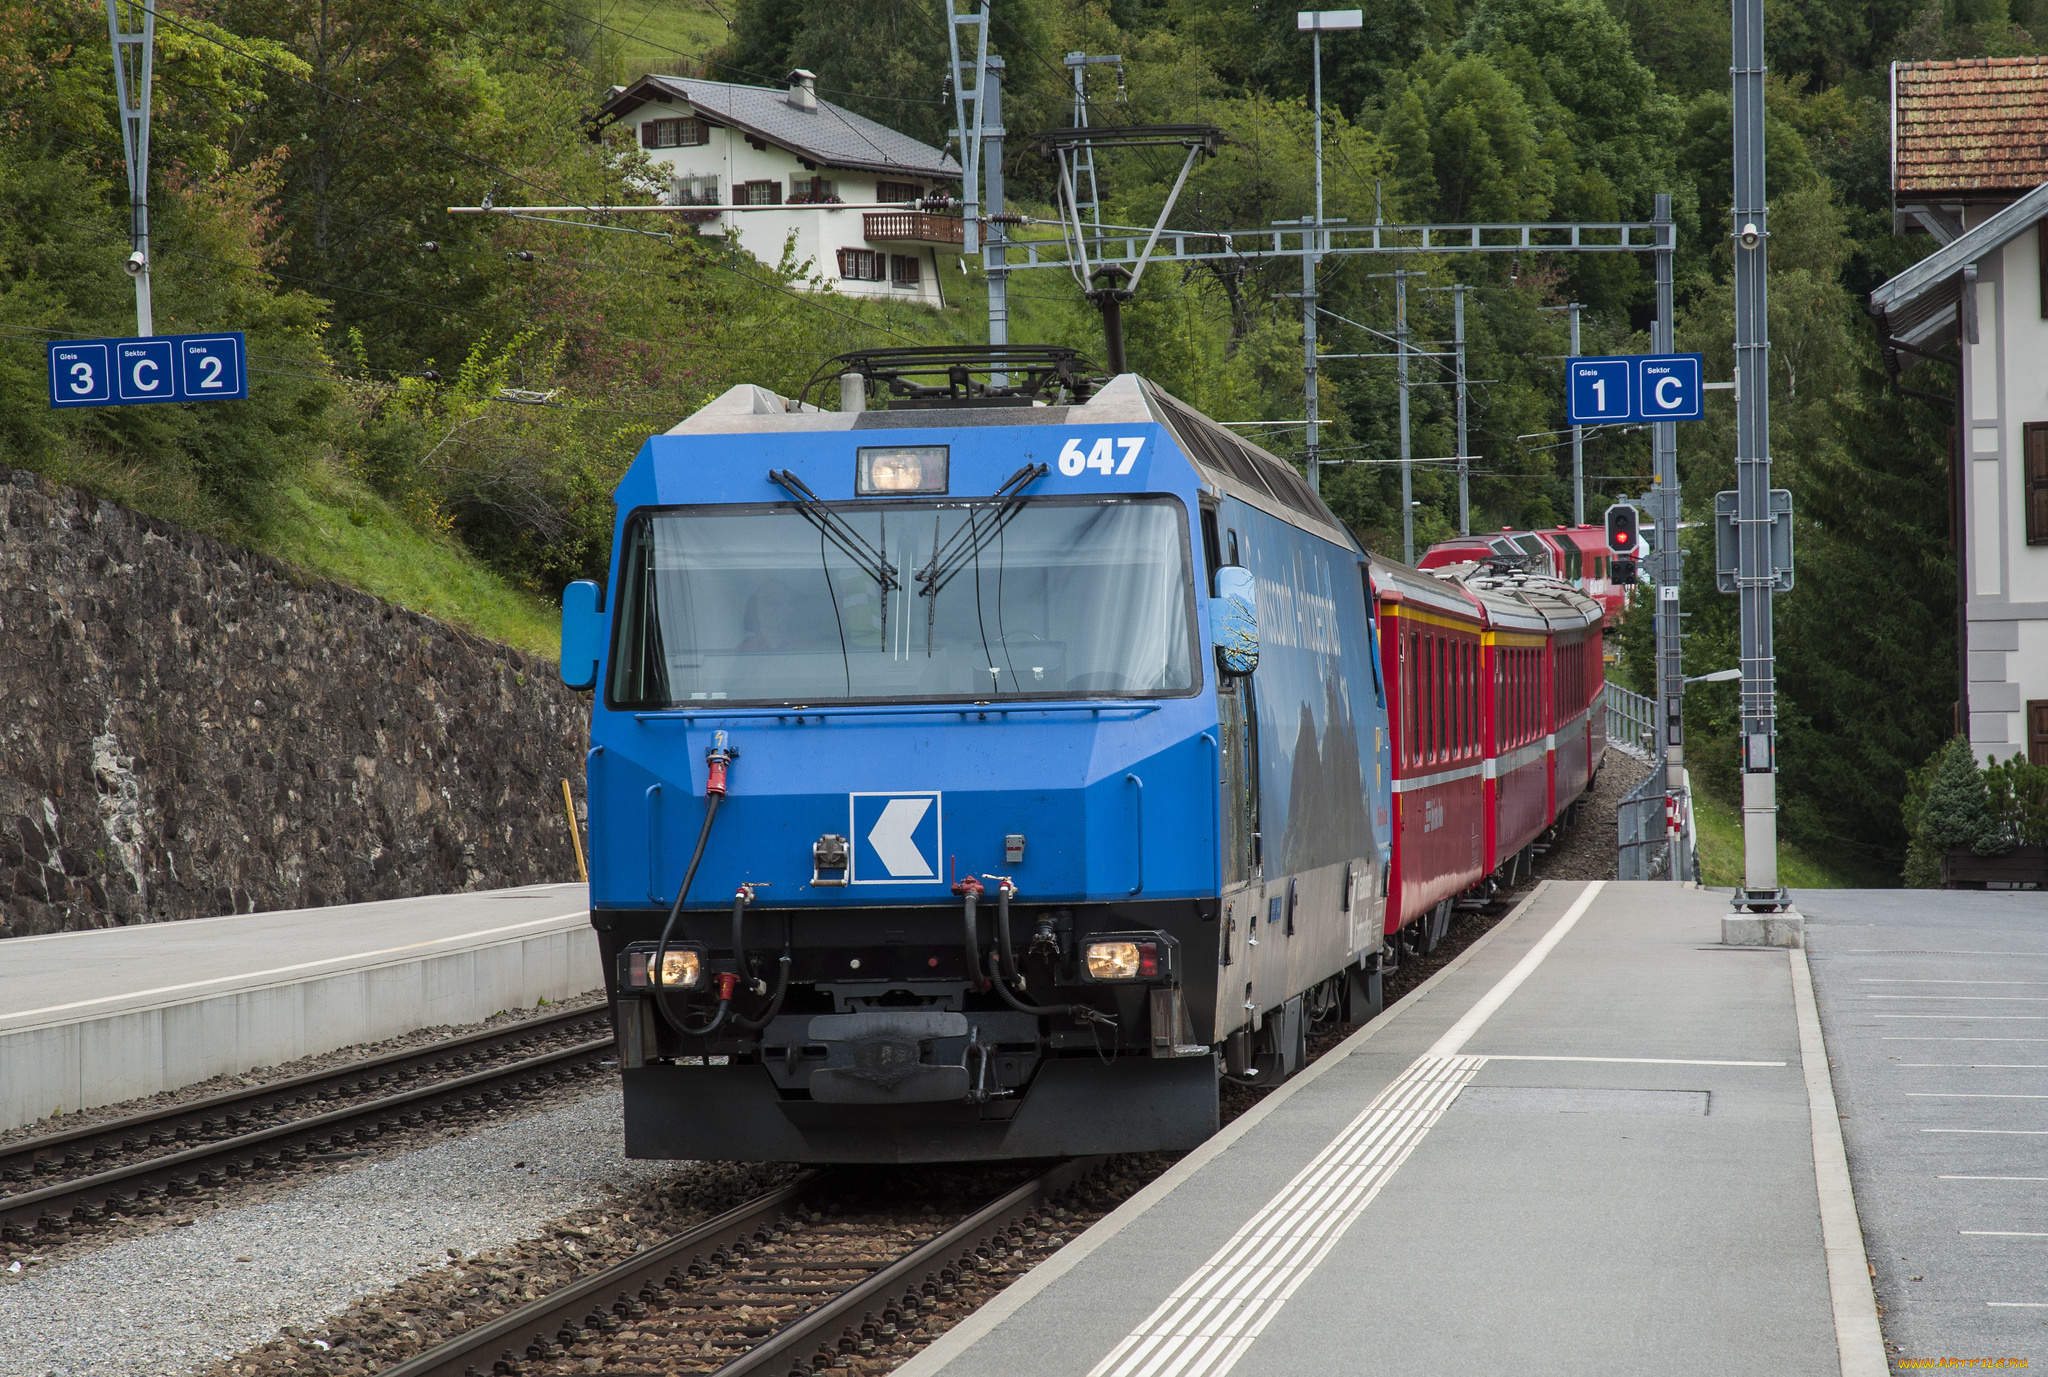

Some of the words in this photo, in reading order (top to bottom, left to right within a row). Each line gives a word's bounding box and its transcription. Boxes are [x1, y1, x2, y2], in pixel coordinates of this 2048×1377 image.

[60, 353, 78, 361] Gleis
[124, 349, 146, 357] Sektor
[189, 346, 207, 354] Gleis
[70, 363, 94, 395] 3
[133, 359, 159, 391] C
[199, 356, 223, 388] 2
[1579, 369, 1598, 377] Gleis
[1647, 366, 1670, 374] Sektor
[1592, 379, 1605, 411] 1
[1655, 376, 1683, 409] C
[1058, 437, 1146, 477] 647
